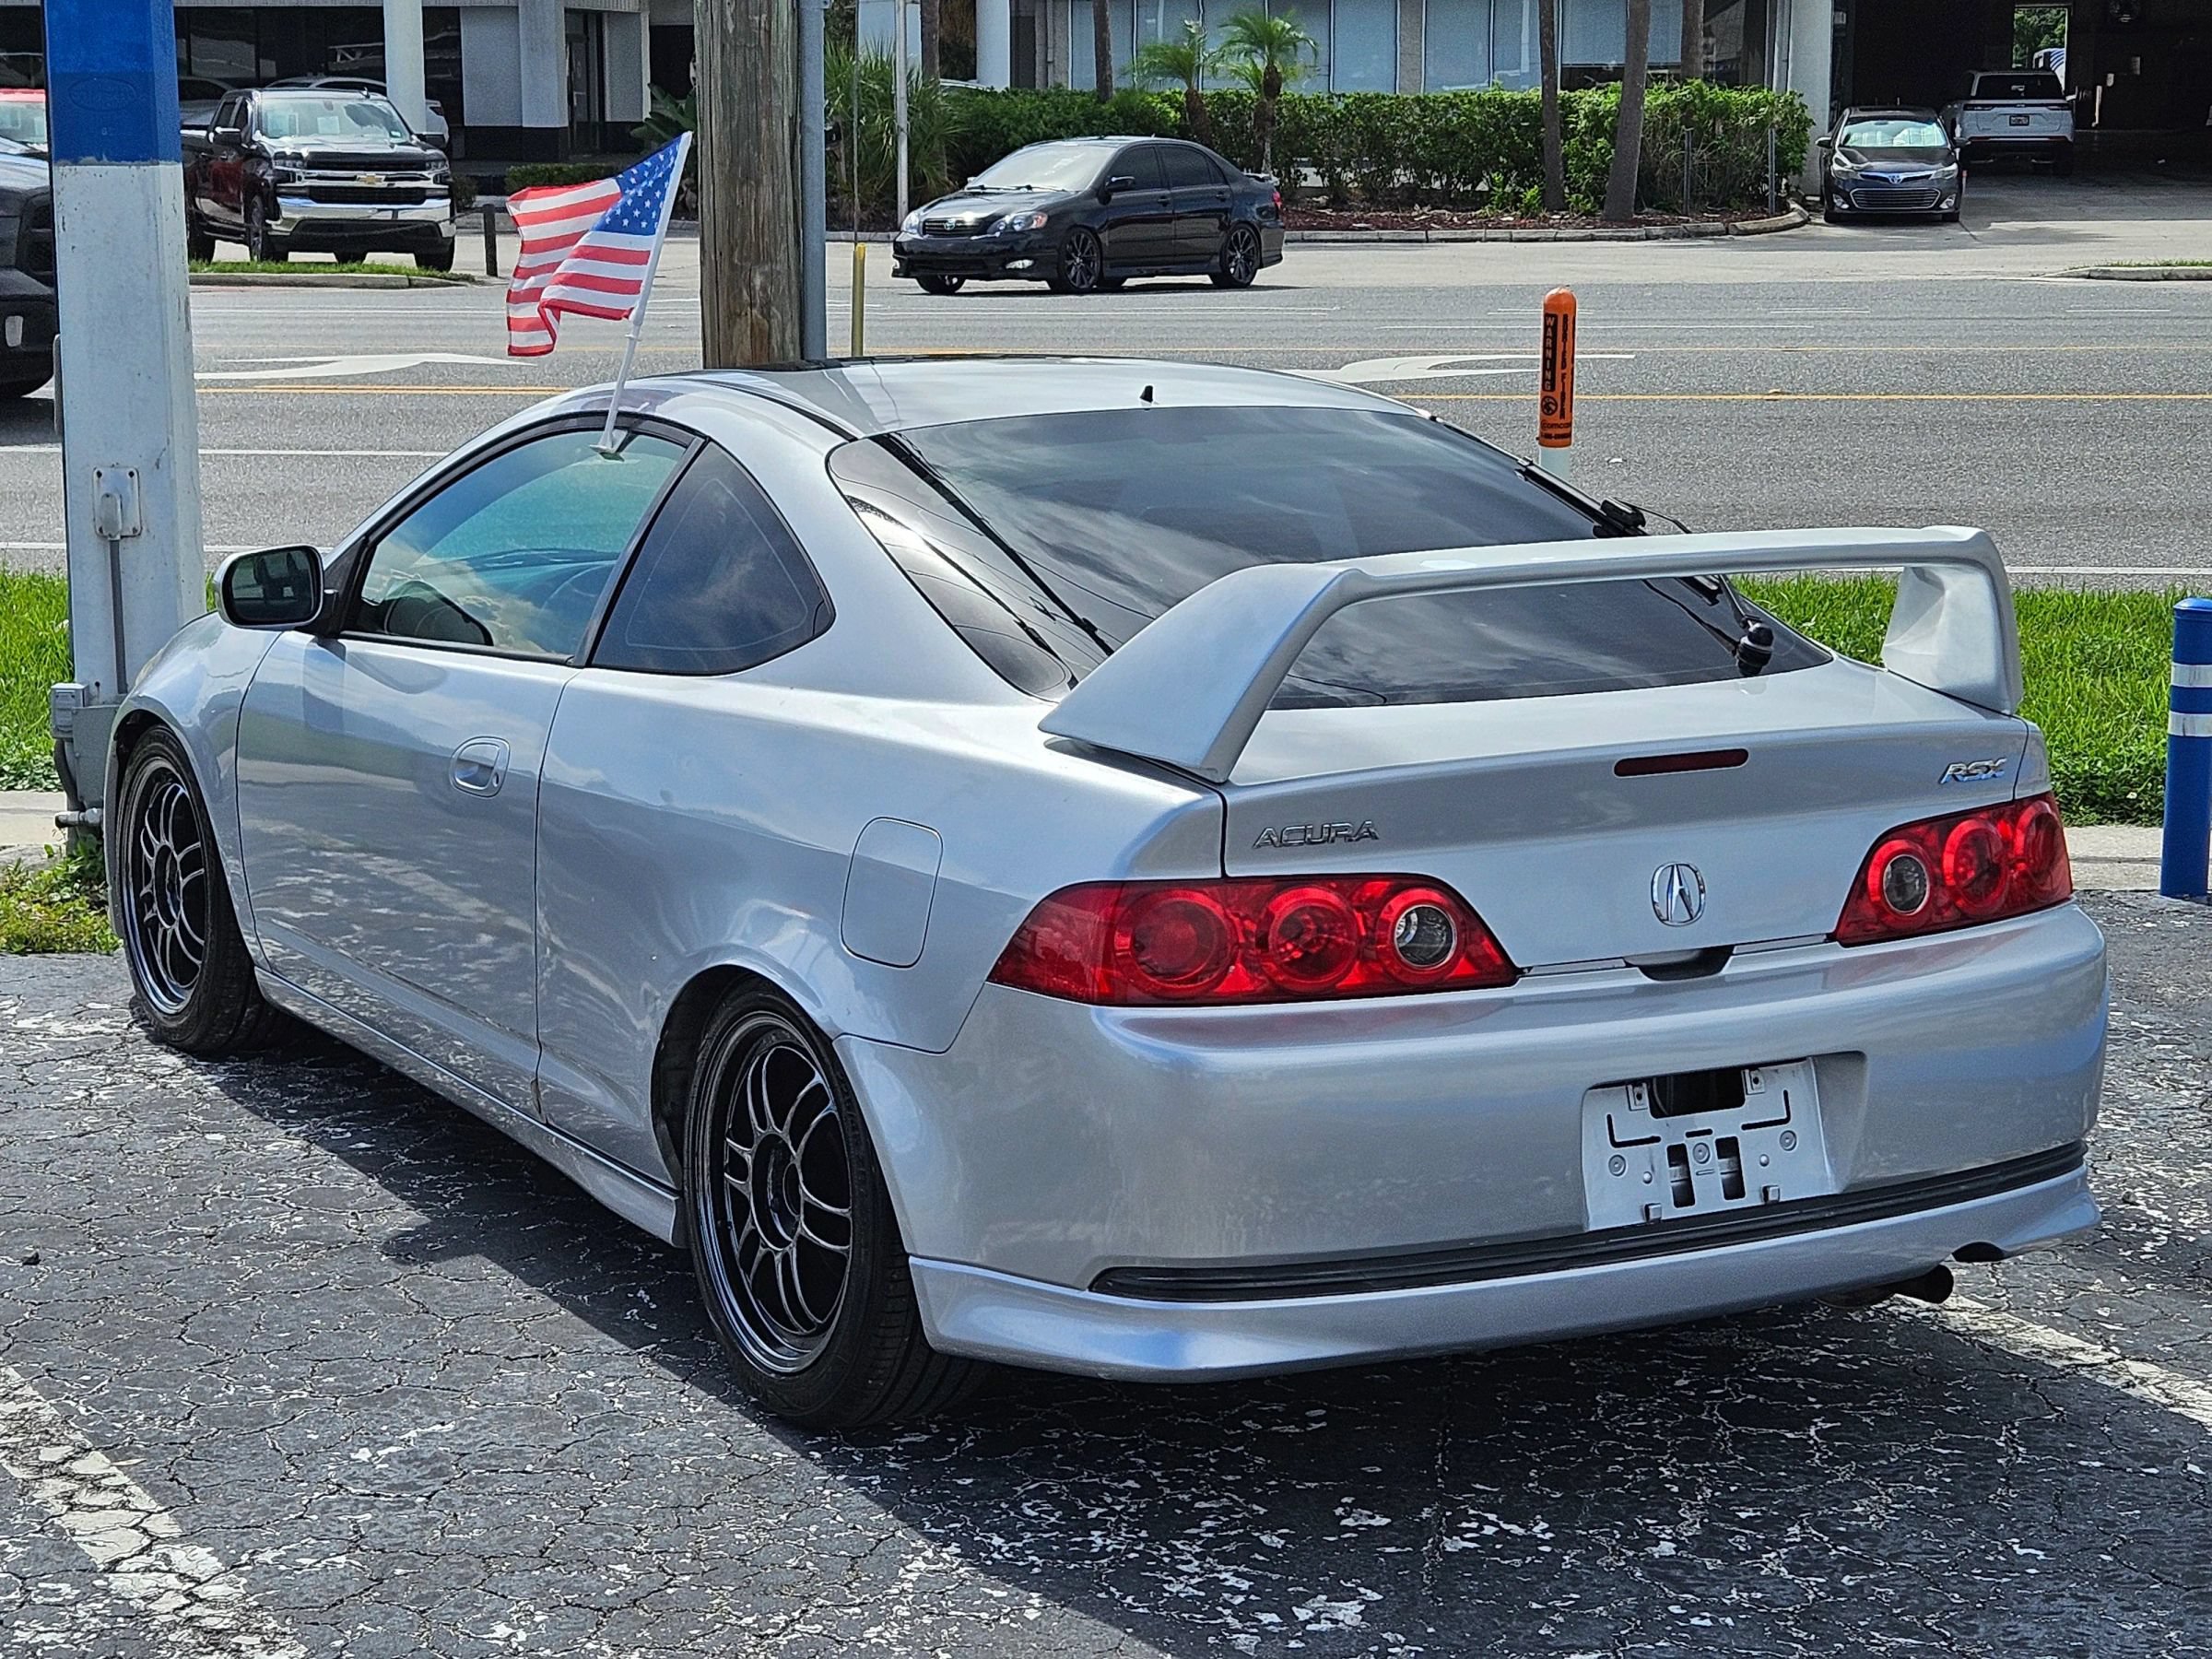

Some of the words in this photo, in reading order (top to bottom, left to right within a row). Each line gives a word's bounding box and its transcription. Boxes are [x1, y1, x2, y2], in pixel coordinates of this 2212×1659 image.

[1545, 316, 1555, 390] WARNING
[1938, 758, 2007, 784] RSX
[1252, 820, 1380, 849] ACURA
